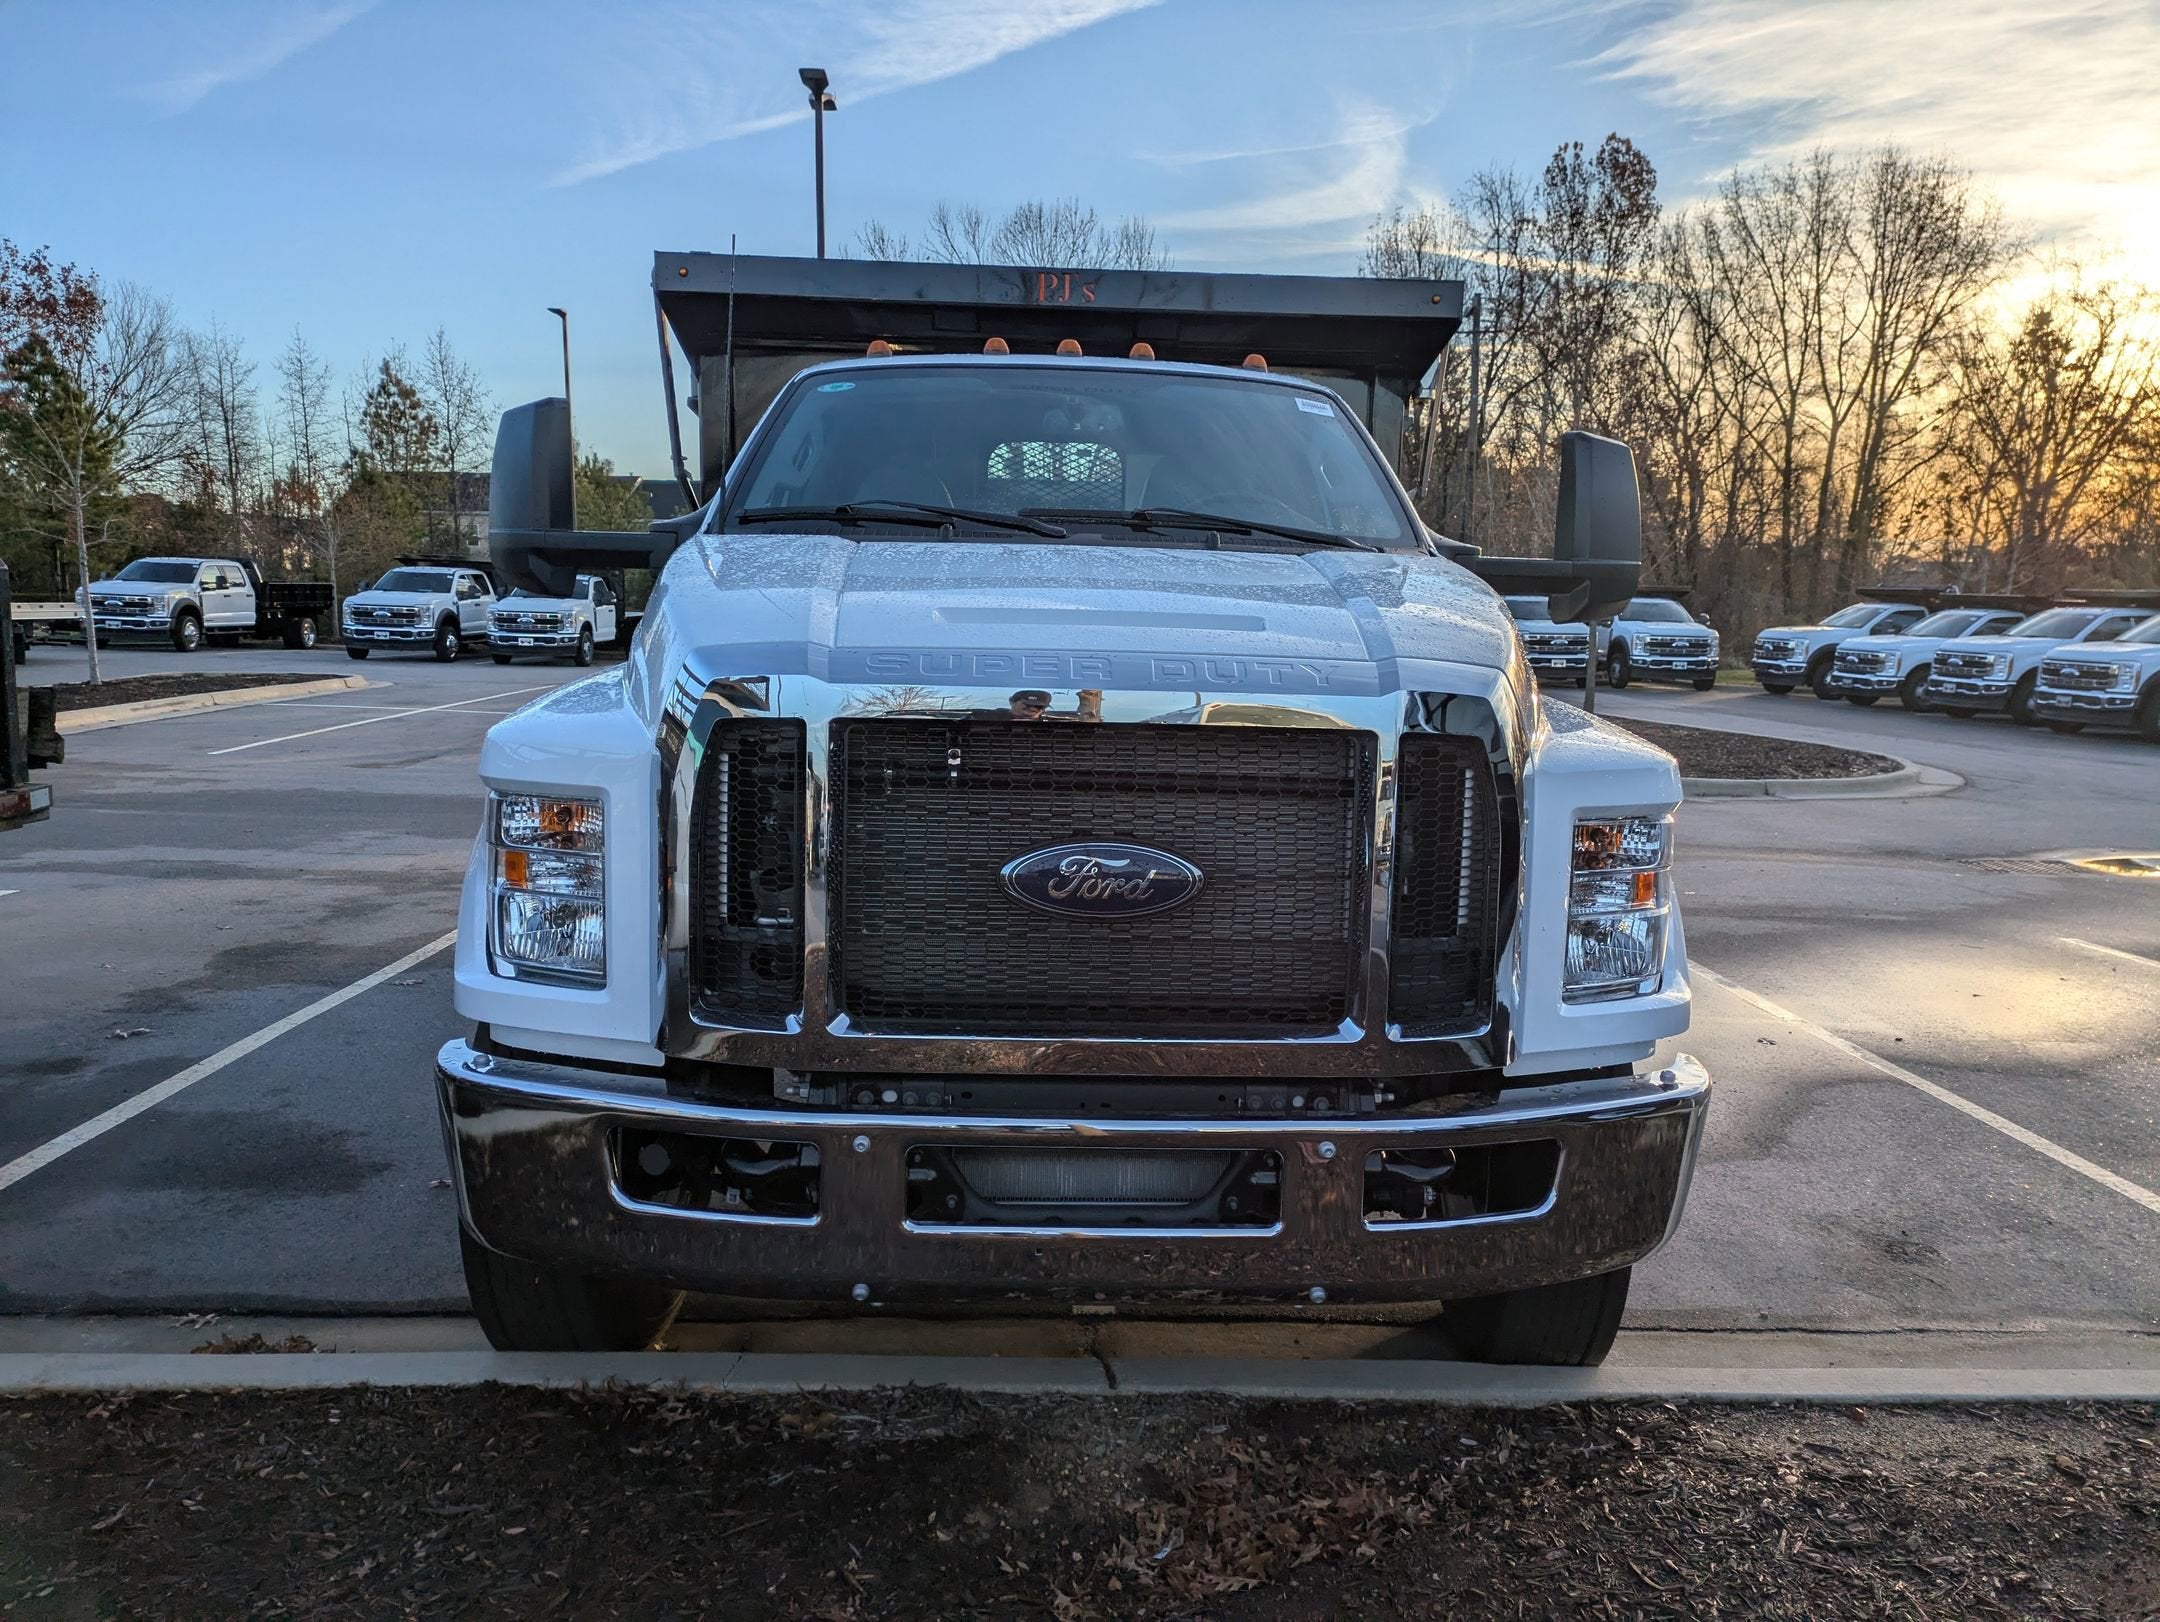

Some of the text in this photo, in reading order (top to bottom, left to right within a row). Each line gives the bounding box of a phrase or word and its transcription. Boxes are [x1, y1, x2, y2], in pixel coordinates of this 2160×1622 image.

[865, 652, 1342, 687] SUPER DUTY
[1048, 855, 1157, 899] Ford
